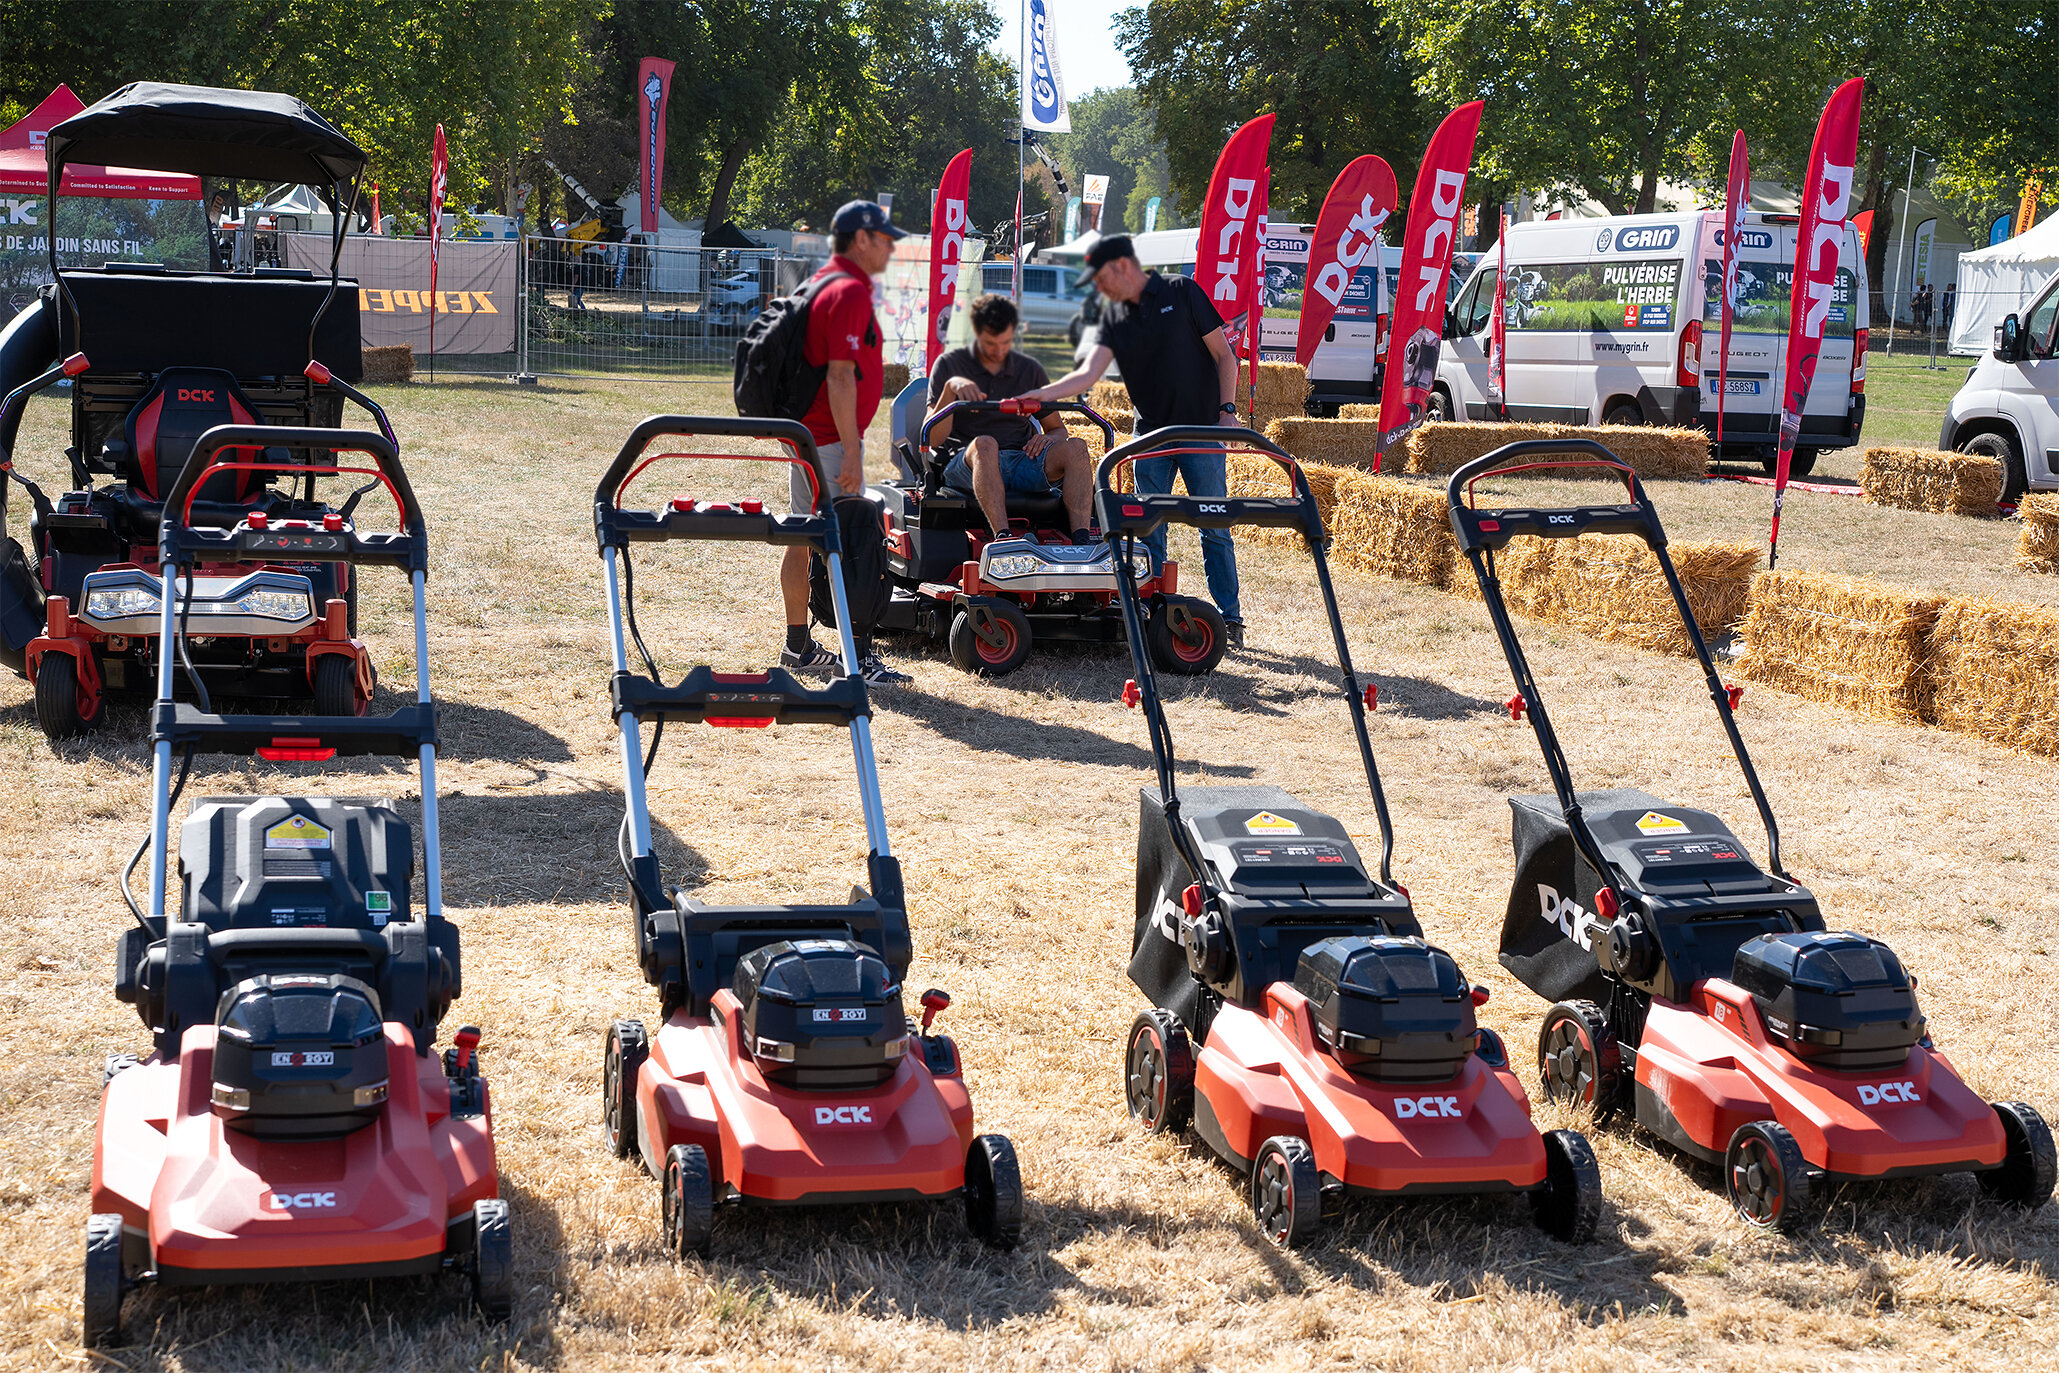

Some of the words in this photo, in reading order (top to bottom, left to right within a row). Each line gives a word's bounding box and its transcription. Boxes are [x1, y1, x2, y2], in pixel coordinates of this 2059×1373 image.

[105, 183, 136, 191] Satisfaction
[6, 236, 24, 250] DE
[83, 239, 119, 254] SANS
[124, 240, 143, 256] FIL
[940, 199, 964, 295] DCK
[1214, 177, 1255, 301] DCK
[1267, 240, 1303, 250] GRIN
[1416, 168, 1465, 313] DCK
[1622, 228, 1672, 248] GRIN
[1313, 192, 1391, 307] DCK
[1805, 160, 1853, 338] DCK
[1603, 262, 1677, 285] PULVÉRISE
[1617, 286, 1673, 304] L'HERBE
[1227, 332, 1241, 344] DCK
[1595, 341, 1649, 352] www.mygrin.fr
[178, 389, 215, 402] DCK
[1730, 381, 1755, 392] 568SZ
[1199, 504, 1227, 514] DCK
[1548, 514, 1575, 524] DCK
[1537, 883, 1598, 952] DCK
[1857, 1082, 1921, 1105] DCK
[814, 1105, 873, 1125] DCK
[1393, 1096, 1463, 1119] DCK
[270, 1191, 336, 1209] DCK
